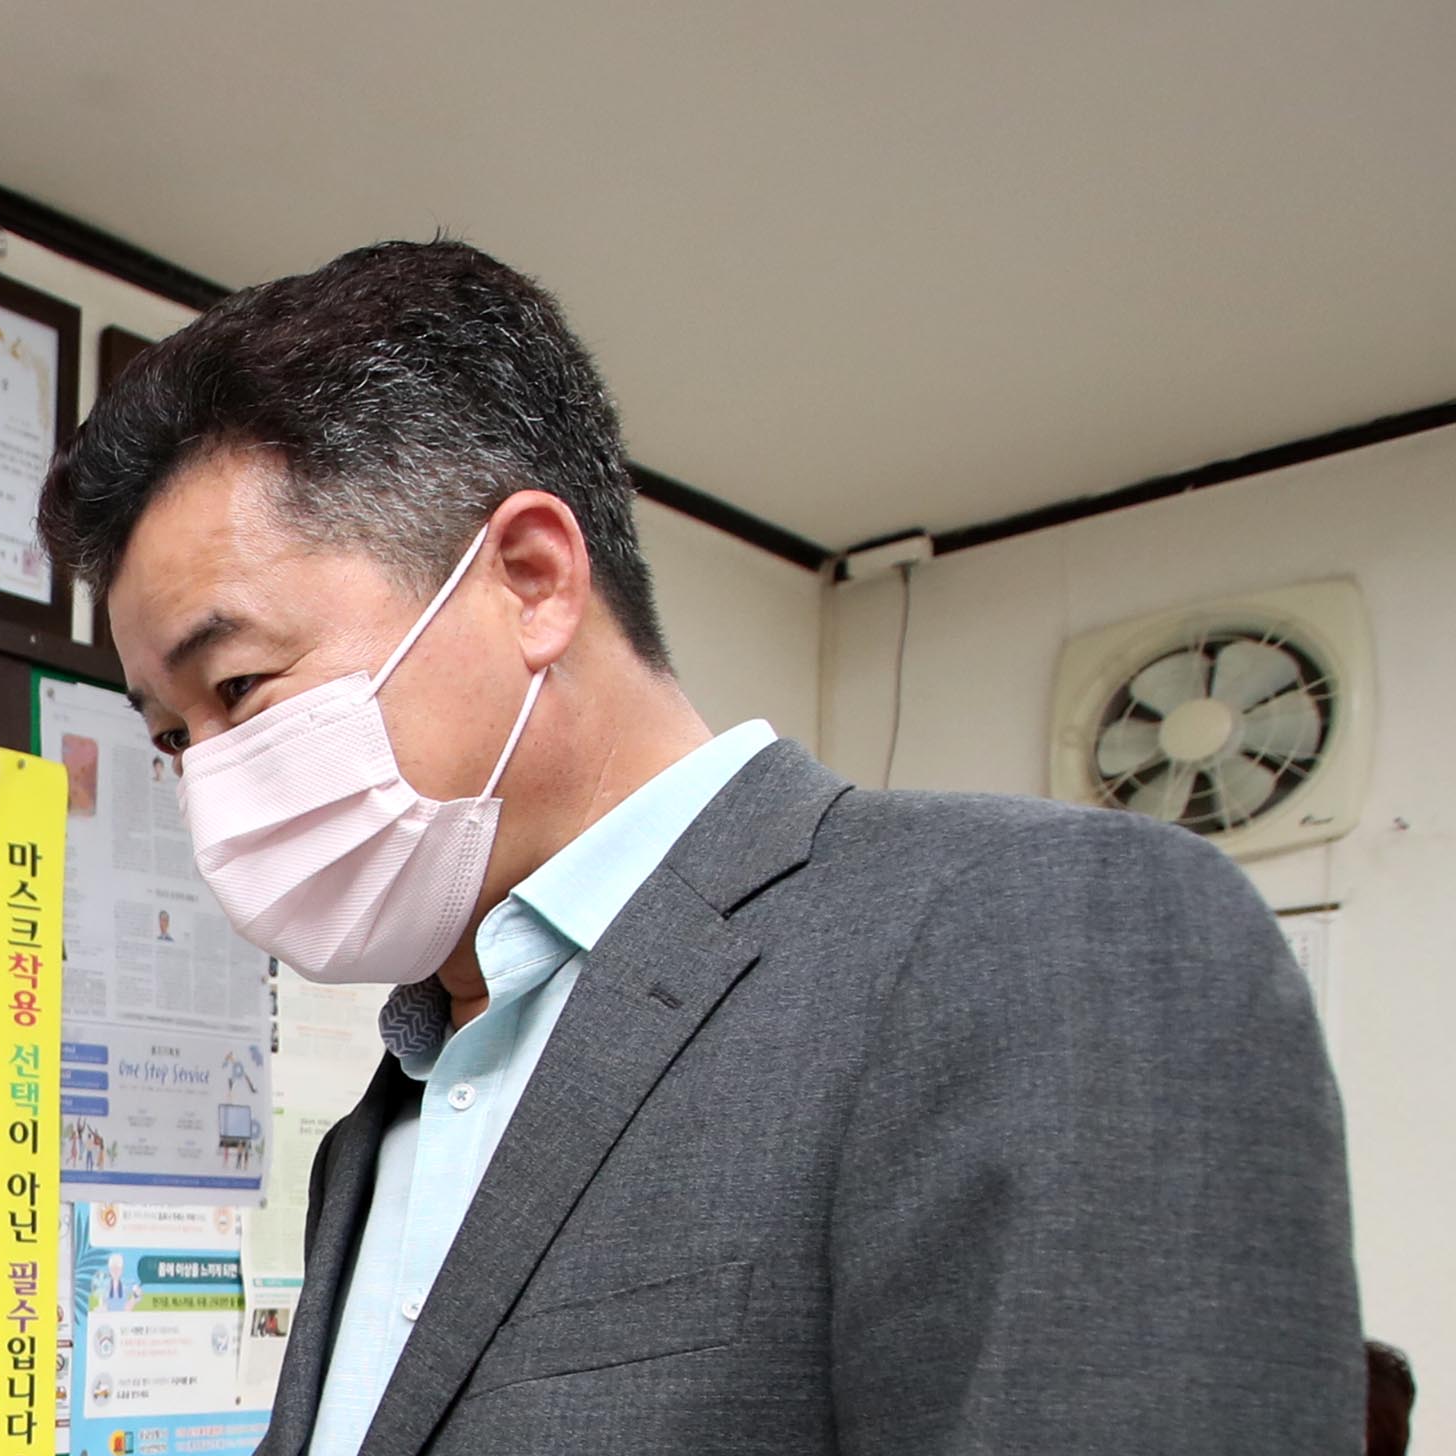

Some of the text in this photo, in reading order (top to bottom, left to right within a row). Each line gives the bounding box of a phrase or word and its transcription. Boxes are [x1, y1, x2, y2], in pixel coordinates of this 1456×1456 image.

[6, 841, 43, 1446] 마스크착용 선택이 아닌 필수입니다
